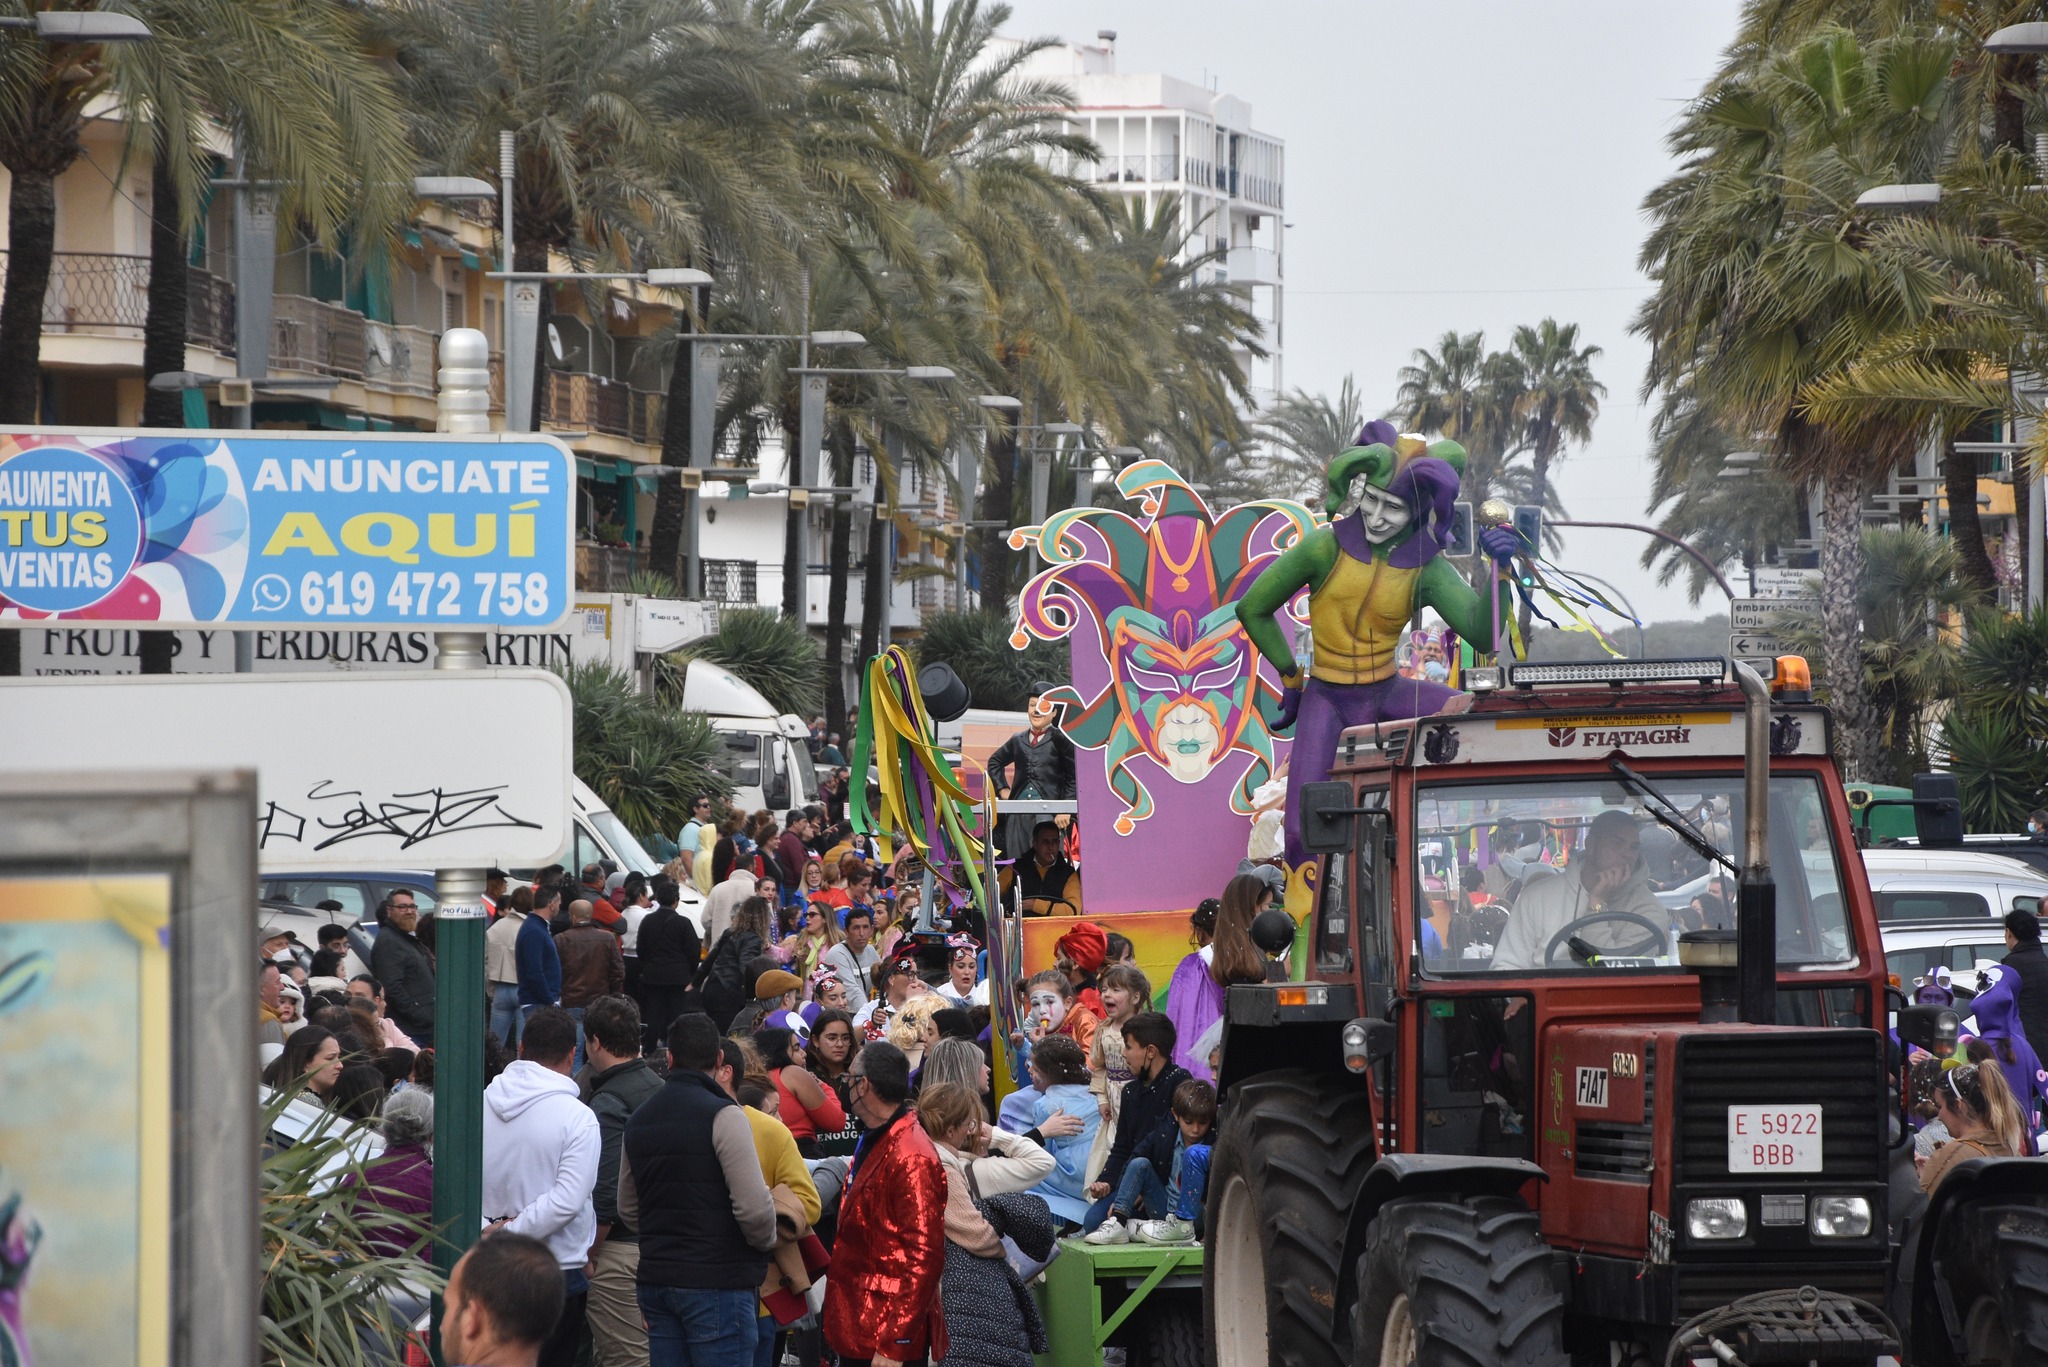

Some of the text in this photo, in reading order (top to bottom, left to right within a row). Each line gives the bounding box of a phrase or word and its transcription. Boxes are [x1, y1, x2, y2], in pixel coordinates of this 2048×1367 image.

[0, 470, 112, 507] AUMENTA
[252, 449, 550, 494] ANÚNCIATE
[0, 511, 108, 547] TUS
[261, 499, 541, 564] AQUÍ
[0, 552, 113, 588] VENTAS
[300, 570, 549, 617] 619 472 758
[43, 630, 182, 658] FRUTS
[255, 631, 429, 663] ERDURAS
[1583, 729, 1691, 747] FIATAGRI
[1578, 1069, 1607, 1105] FIAT
[817, 1131, 860, 1141] ENOUG
[1736, 1113, 1817, 1135] E 5922
[1753, 1144, 1794, 1165] BBB
